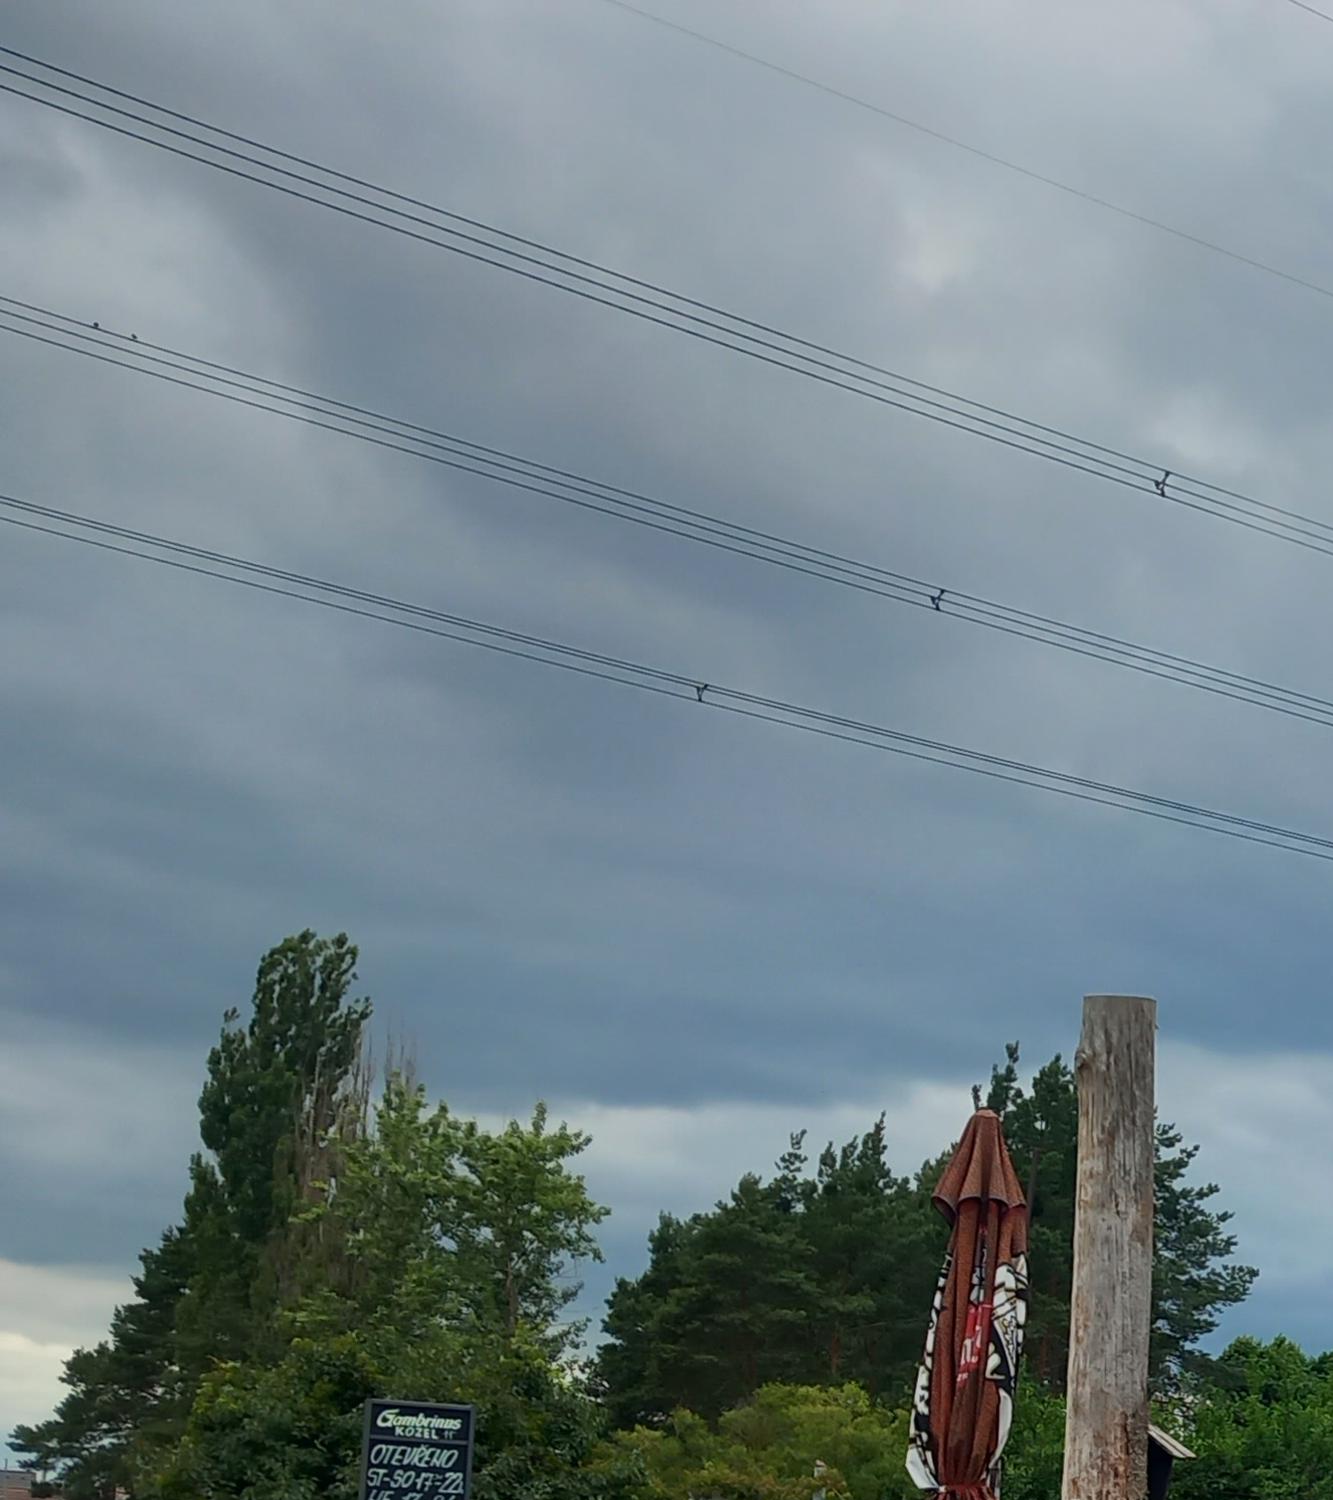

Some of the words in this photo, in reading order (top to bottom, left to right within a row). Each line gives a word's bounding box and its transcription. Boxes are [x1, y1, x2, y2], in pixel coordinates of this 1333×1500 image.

[376, 1408, 463, 1431] Gambrinus
[394, 1426, 439, 1440] KOZEL
[370, 1443, 459, 1469] OTEVŘENO
